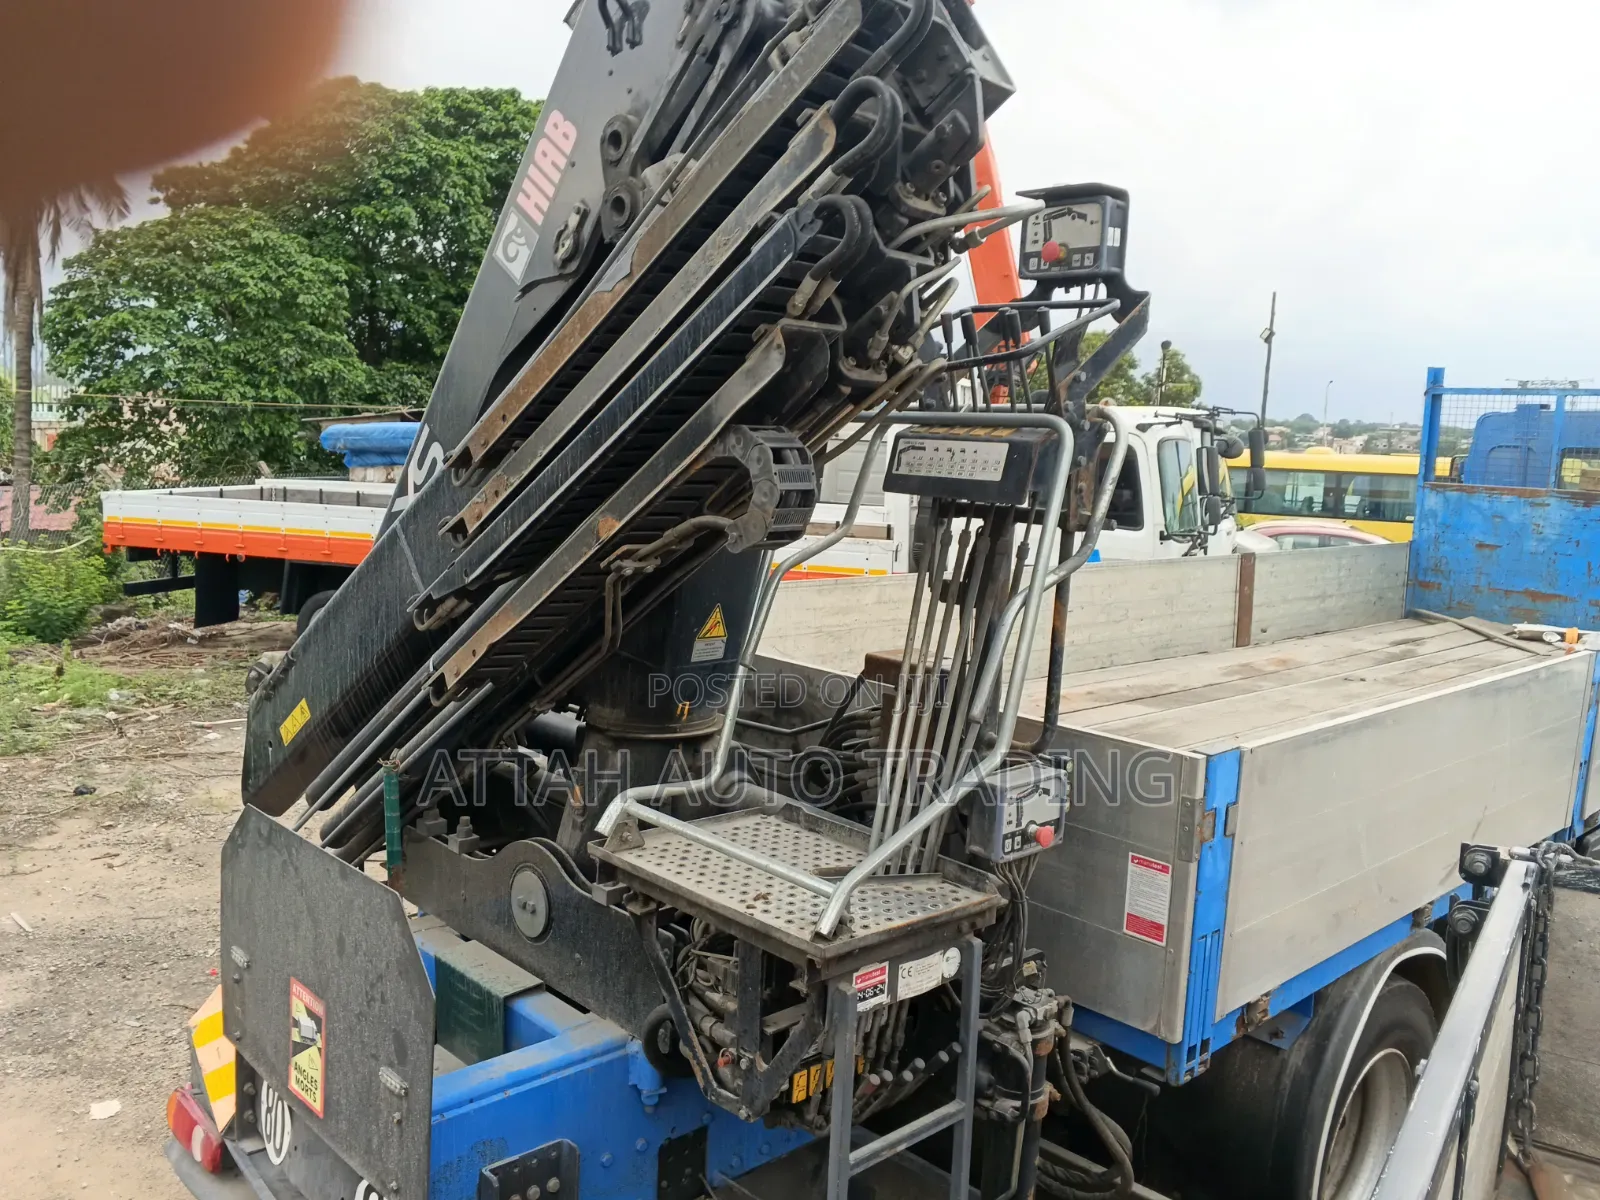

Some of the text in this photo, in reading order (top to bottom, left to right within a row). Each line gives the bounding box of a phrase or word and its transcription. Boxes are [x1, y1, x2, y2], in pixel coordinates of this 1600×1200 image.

[516, 110, 577, 226] HIAB
[292, 984, 324, 1016] ATTENTION
[294, 1061, 318, 1091] ANGLES
[295, 1075, 317, 1103] MORTS
